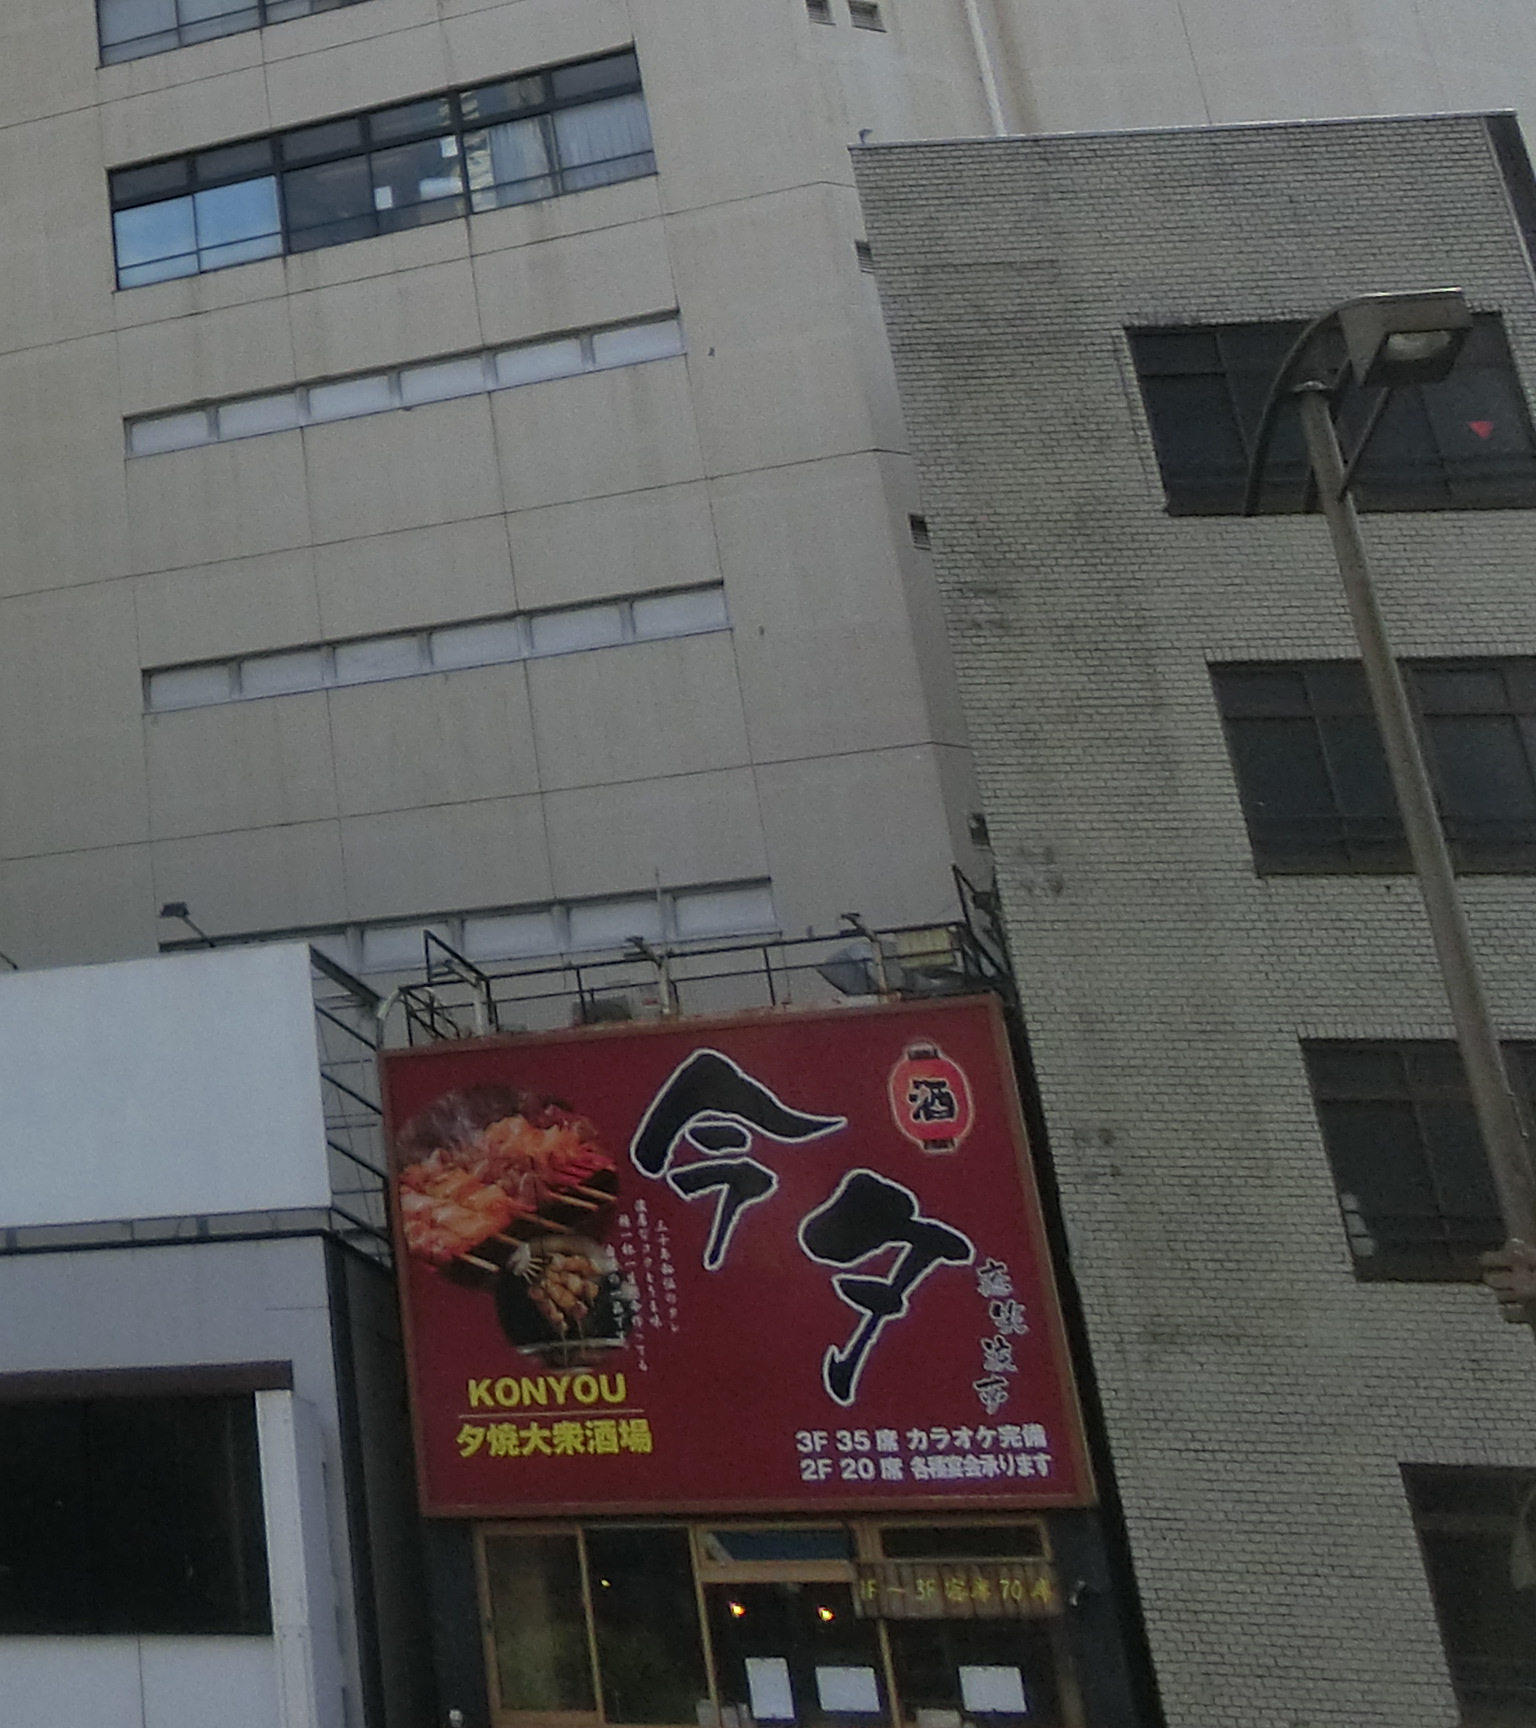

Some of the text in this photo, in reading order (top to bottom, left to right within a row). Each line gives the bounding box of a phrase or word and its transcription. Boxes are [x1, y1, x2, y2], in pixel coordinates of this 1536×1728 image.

[906, 1075, 958, 1125] 酒
[467, 1373, 628, 1409] KONYOU
[455, 1419, 654, 1460] 夕焼大衆酒場
[795, 1430, 828, 1453] 3F
[836, 1429, 871, 1453] 35
[906, 1424, 1048, 1451] カラオケ完備
[800, 1458, 833, 1481] 2F
[839, 1457, 876, 1480] 20
[999, 1579, 1022, 1602] 70
